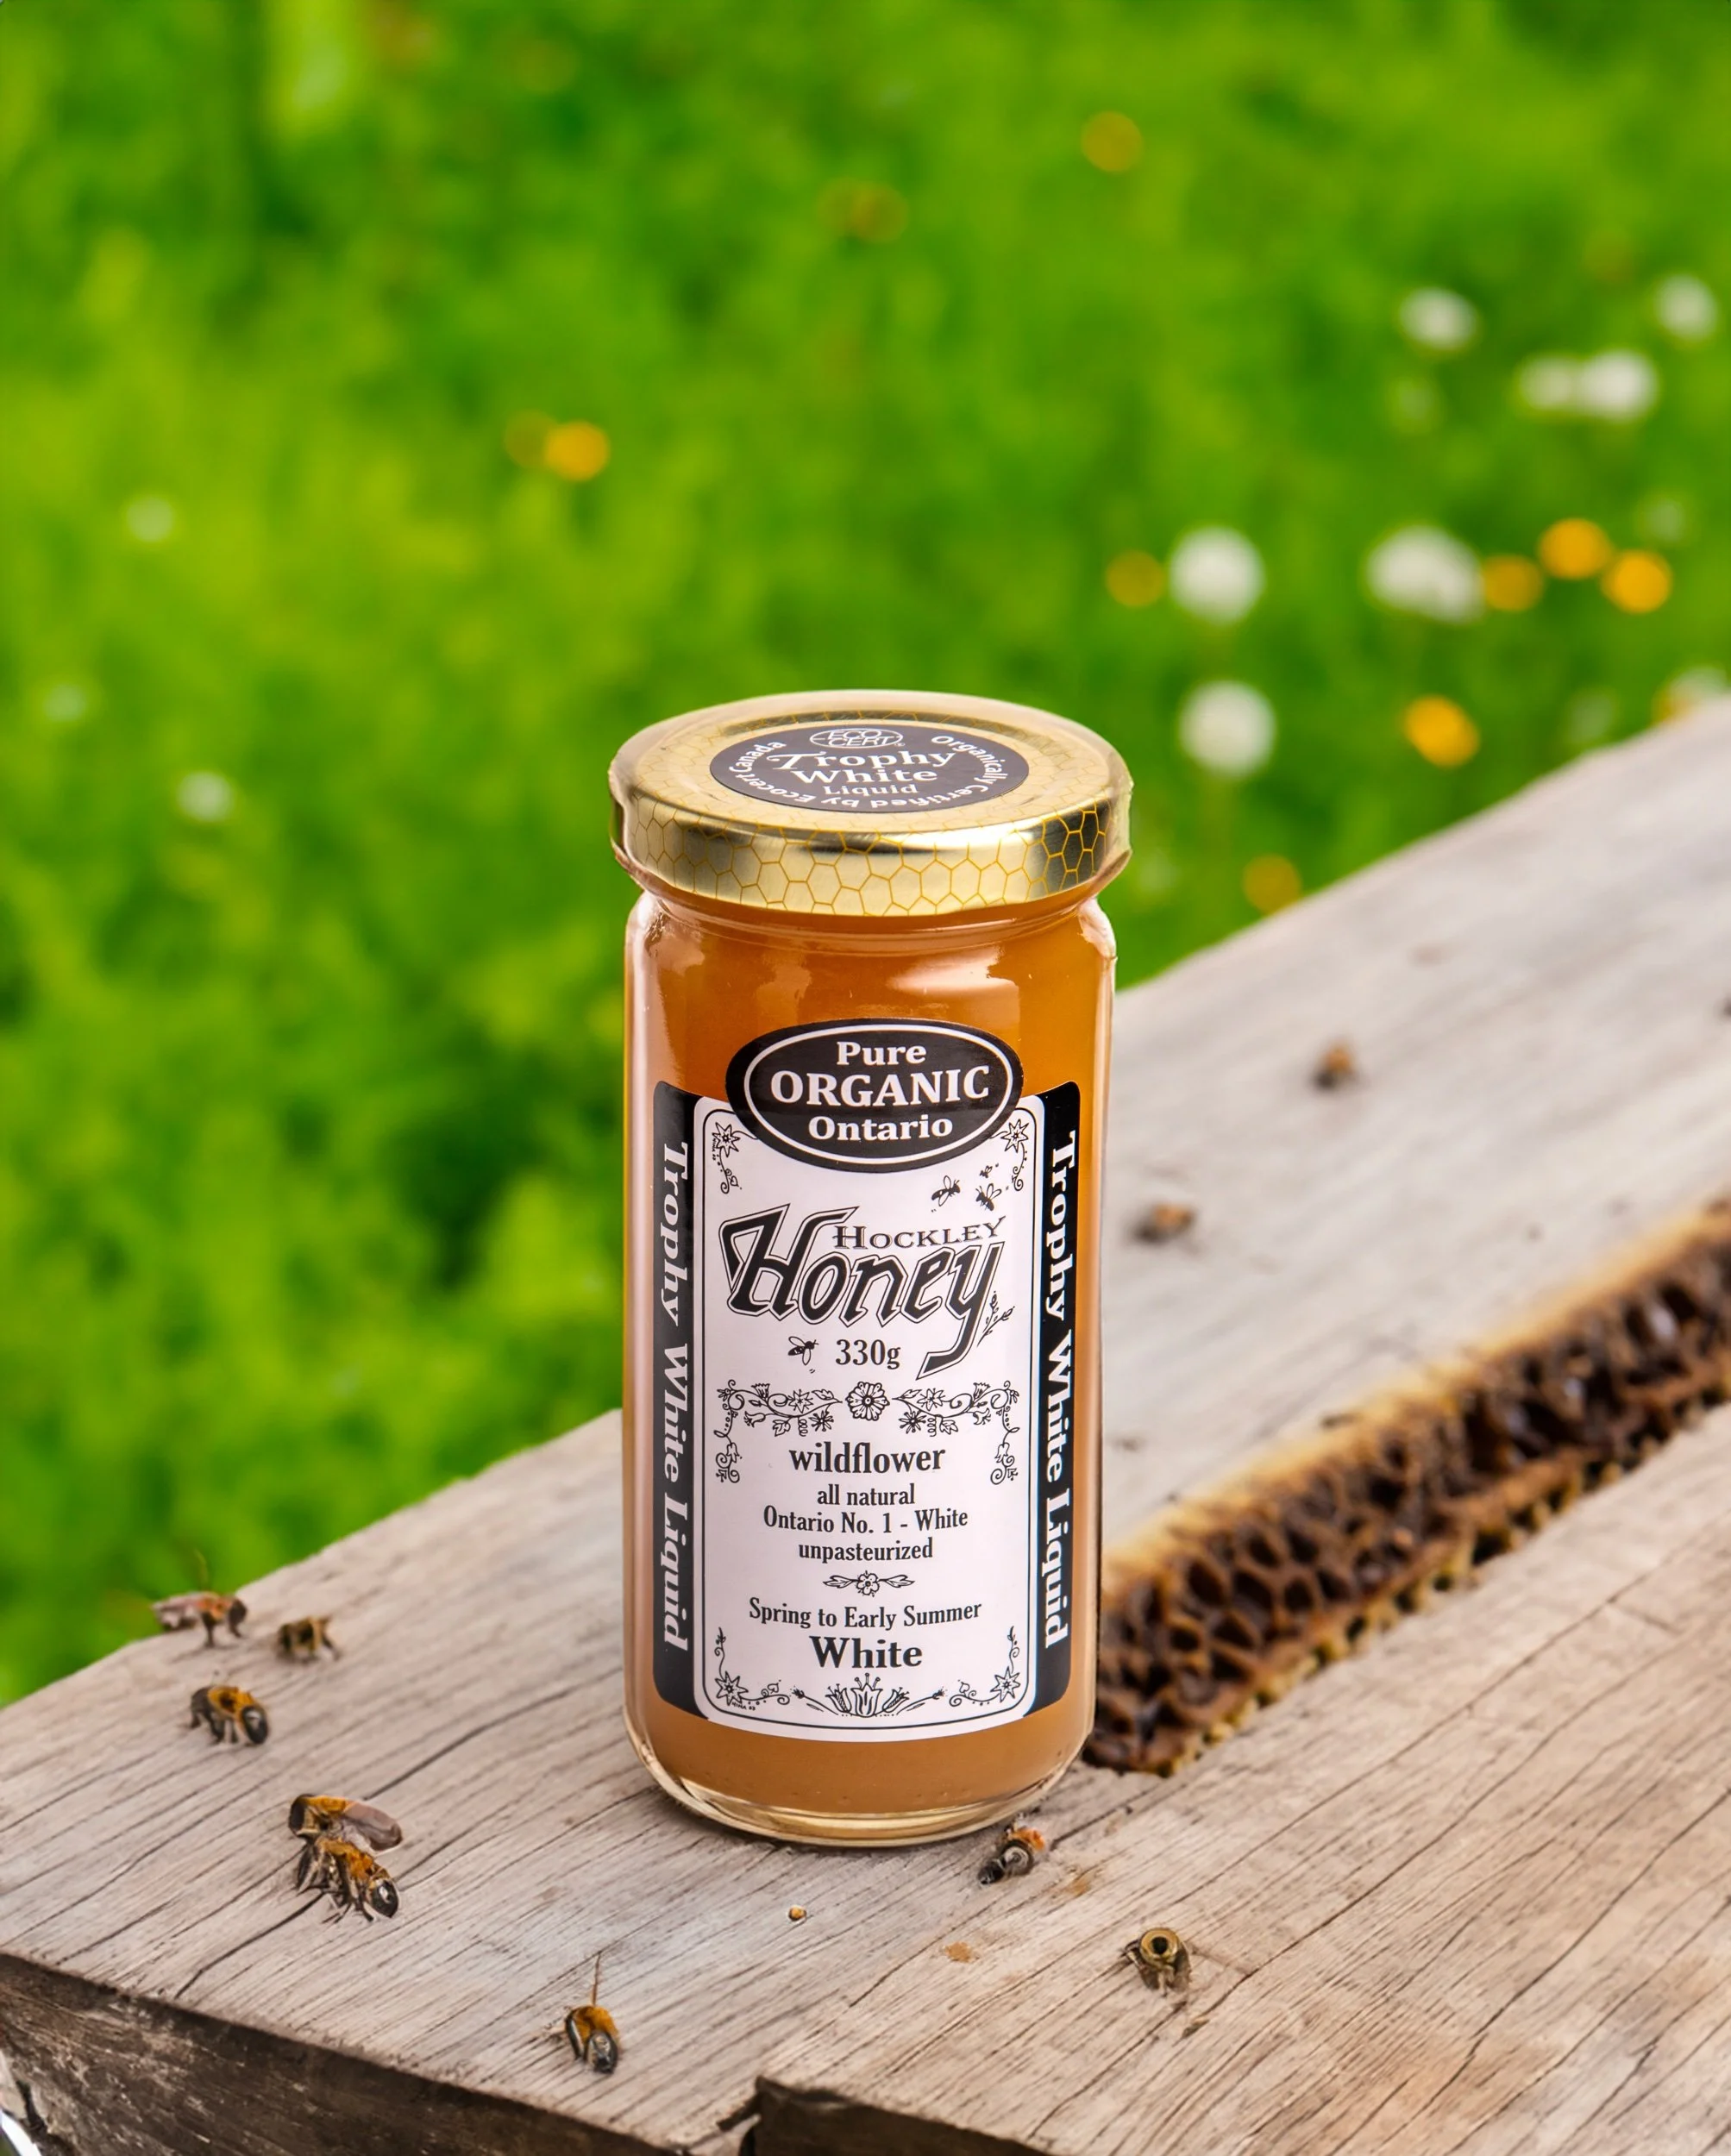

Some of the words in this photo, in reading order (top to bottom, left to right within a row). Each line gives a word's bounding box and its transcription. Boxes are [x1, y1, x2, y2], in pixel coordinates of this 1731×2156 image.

[729, 742, 787, 773] Canada
[766, 751, 956, 769] Trophy
[931, 736, 1008, 785] Organically
[735, 774, 816, 803] Ecocert
[790, 768, 938, 784] White
[822, 783, 919, 797] Liquid
[821, 797, 860, 807] by
[870, 784, 988, 808] Certified
[837, 1041, 926, 1066] Pure
[770, 1065, 989, 1107] ORGANIC
[808, 1114, 953, 1141] Ontario
[661, 1143, 688, 1326] Trophy
[834, 1216, 1007, 1250] HOCKLEY
[1045, 1130, 1076, 1321] Trophy
[718, 1203, 1005, 1381] Honey
[835, 1338, 901, 1369] 330g
[662, 1343, 688, 1482] White
[1045, 1329, 1074, 1482] White
[789, 1442, 946, 1474] wildflower
[817, 1484, 841, 1506] all
[846, 1483, 916, 1506] natural
[763, 1506, 835, 1531] Ontario
[841, 1512, 875, 1533] No.
[882, 1513, 892, 1533] 1
[914, 1507, 969, 1531] White
[799, 1538, 934, 1563] unpasteurized
[661, 1491, 688, 1651] Liquid
[1043, 1488, 1071, 1649] Liquid
[749, 1597, 812, 1628] Spring
[818, 1609, 838, 1627] to
[844, 1606, 897, 1631] Early
[903, 1601, 982, 1626] Summer
[809, 1636, 923, 1669] White
